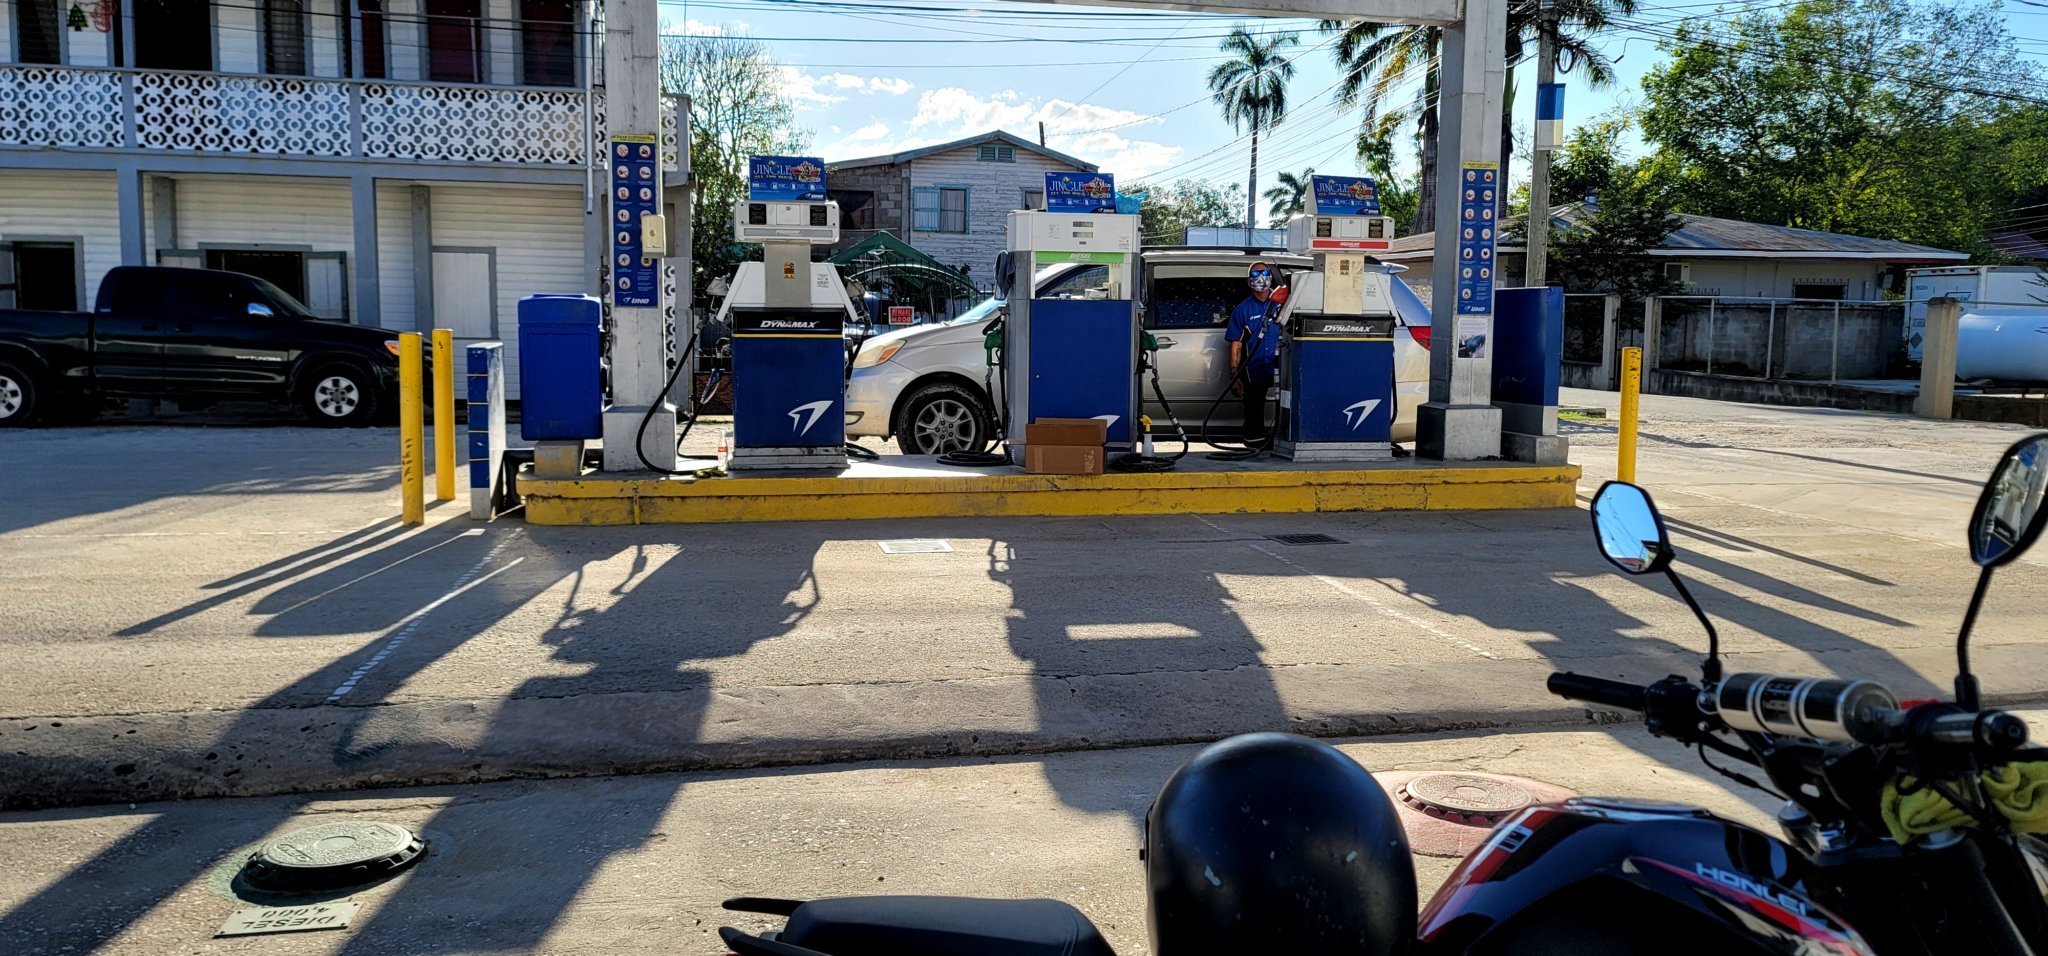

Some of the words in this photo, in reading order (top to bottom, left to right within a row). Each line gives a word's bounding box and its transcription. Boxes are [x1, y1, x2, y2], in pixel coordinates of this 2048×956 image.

[753, 163, 792, 176] JINGLE
[1049, 180, 1084, 192] JINGLE
[1316, 182, 1349, 193] JINGLE
[760, 320, 818, 329] DYNAMAX
[1322, 324, 1374, 333] DYNAMAX
[1695, 862, 1807, 916] HONLEI
[242, 916, 336, 930] DIESEL
